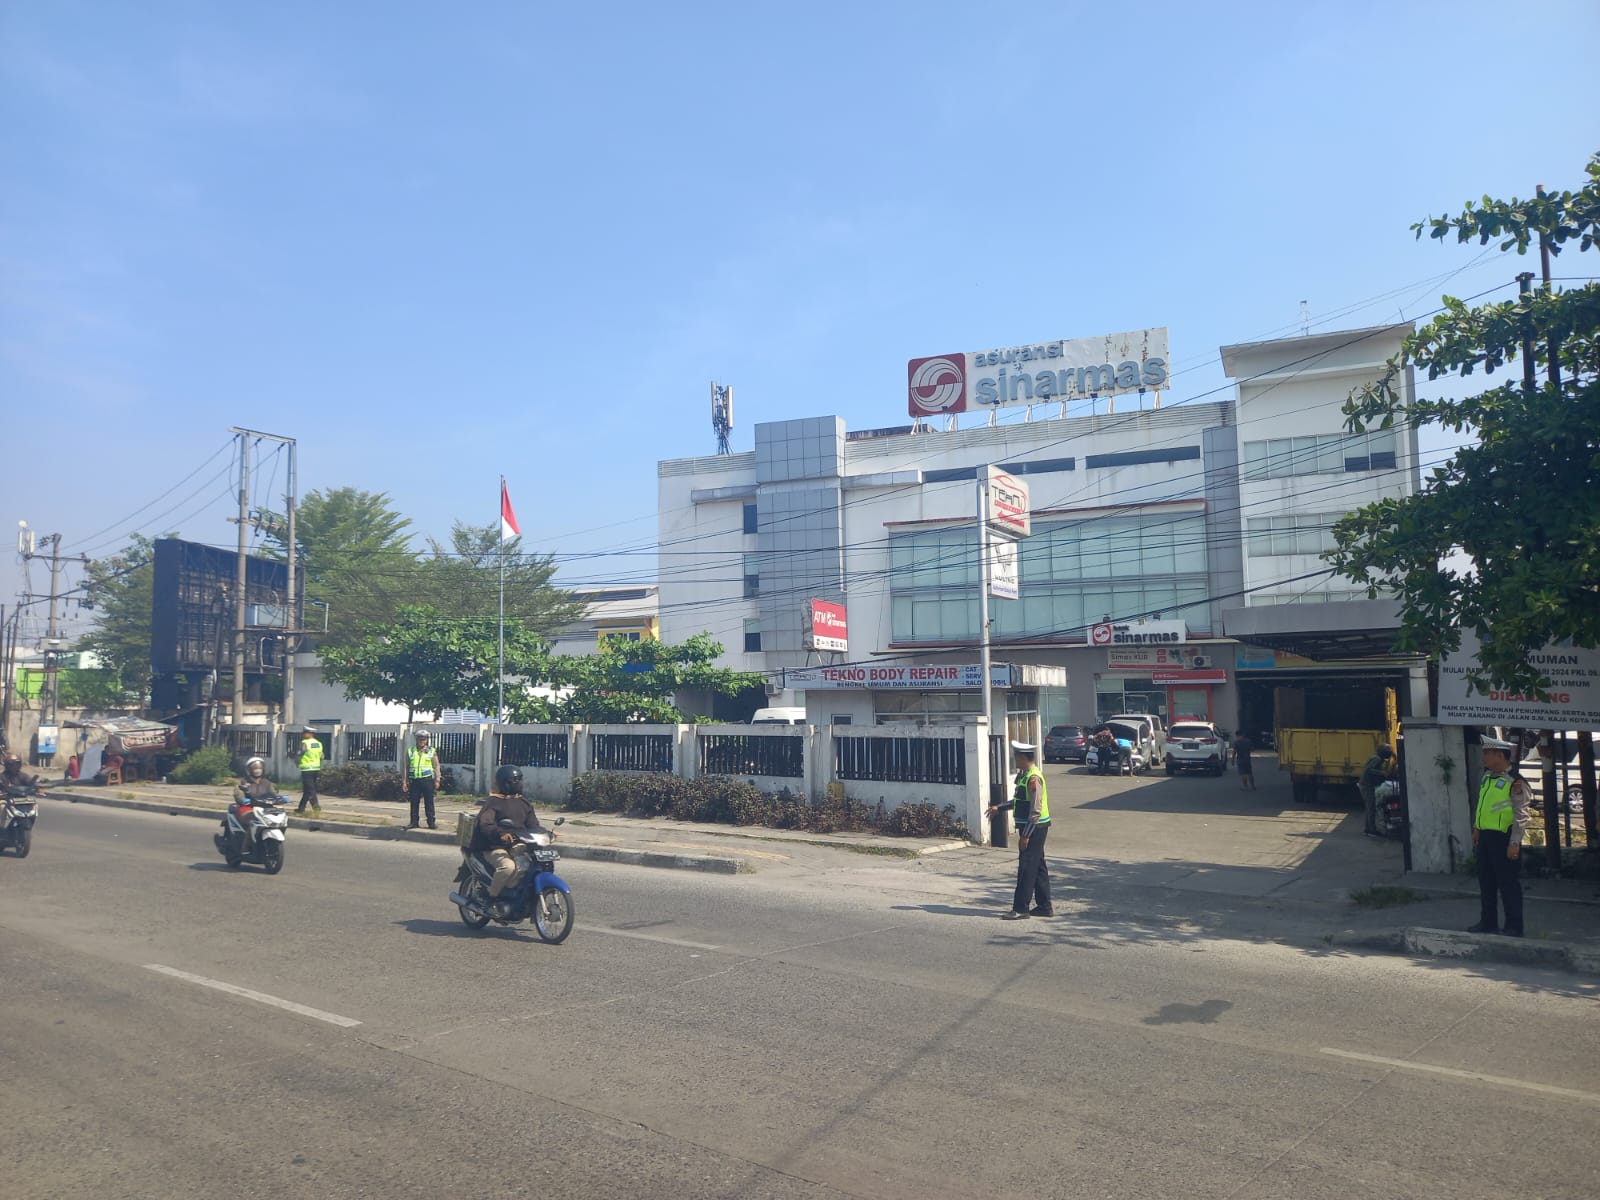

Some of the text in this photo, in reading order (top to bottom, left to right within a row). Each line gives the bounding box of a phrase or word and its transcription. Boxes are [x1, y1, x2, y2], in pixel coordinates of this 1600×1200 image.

[975, 340, 1064, 367] asuransi
[975, 357, 1167, 404] sinarmas
[1114, 632, 1179, 643] sinarmas
[822, 669, 866, 681] TEKNO
[870, 668, 905, 681] BODY
[910, 667, 958, 680] REPAIR
